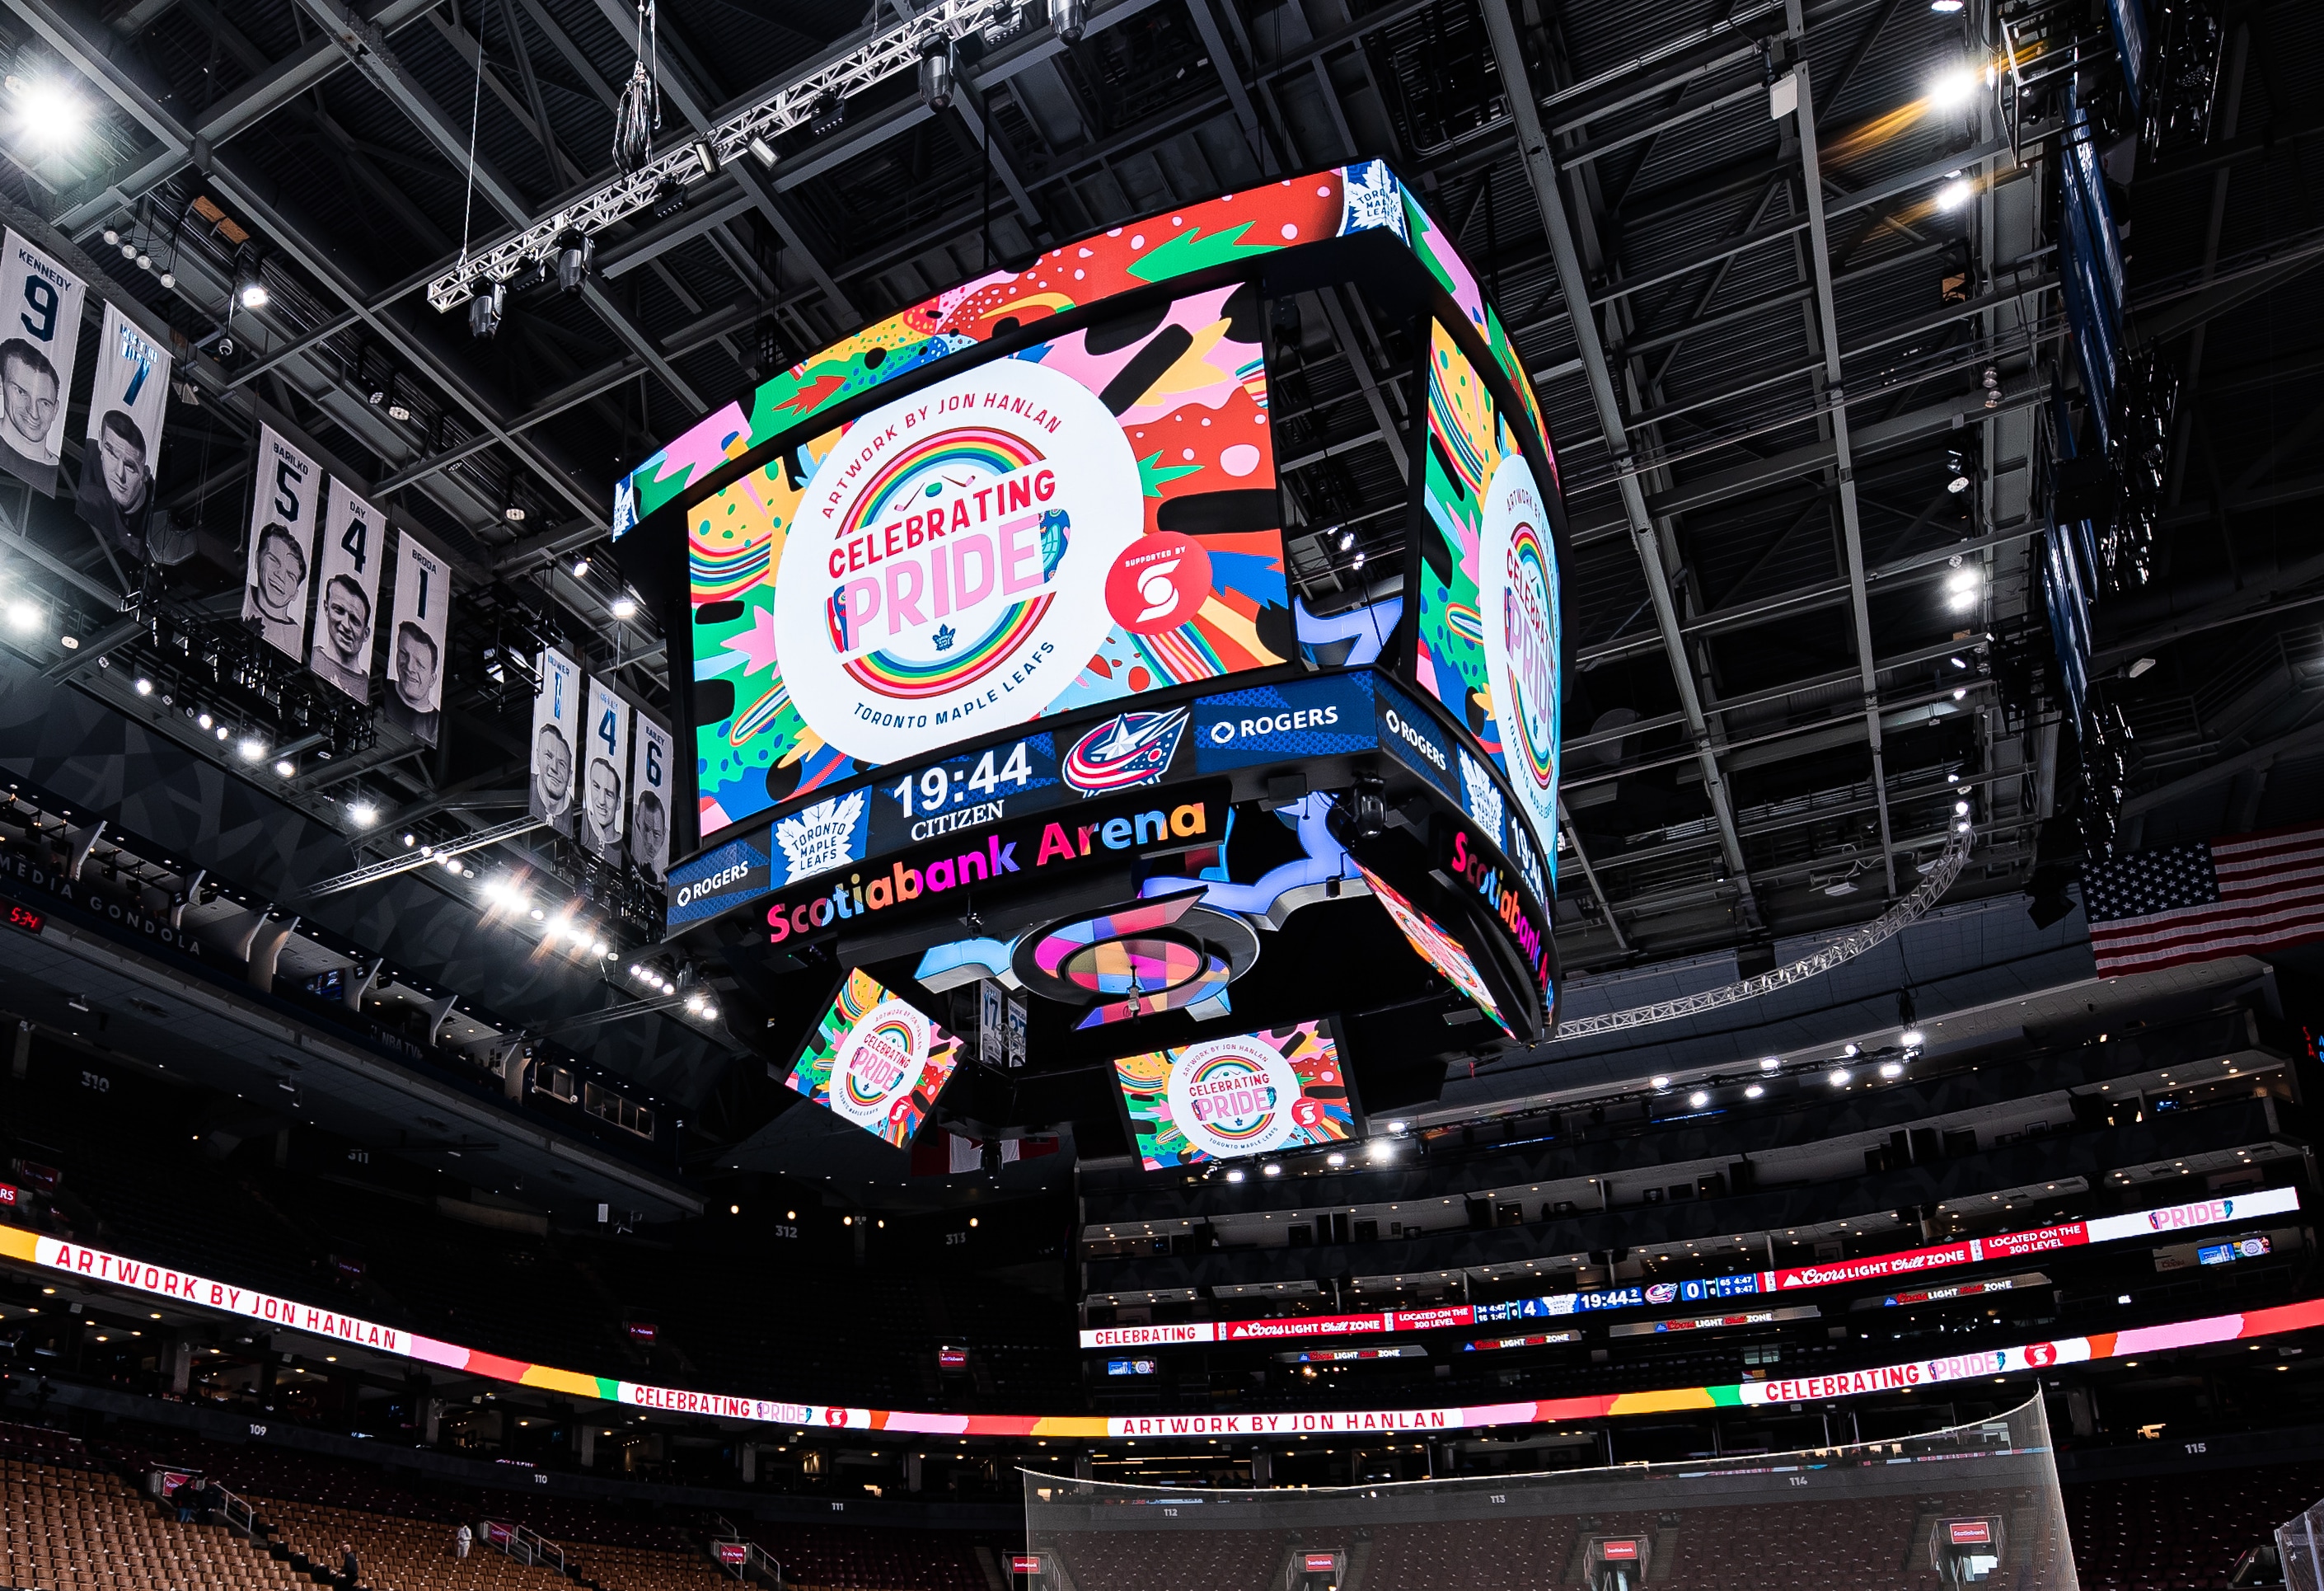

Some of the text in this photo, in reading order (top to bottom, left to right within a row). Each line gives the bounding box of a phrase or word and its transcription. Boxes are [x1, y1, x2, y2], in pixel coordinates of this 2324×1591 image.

[18, 248, 72, 292] KENNEDY
[21, 275, 59, 342] 9
[273, 441, 310, 476] BARILKO
[822, 392, 1062, 519] ARTWORK BY JON HANLAN
[274, 458, 302, 523] 5
[349, 500, 367, 519] DAY
[828, 469, 1056, 578] CELEBRATING
[340, 517, 368, 575] 4
[1125, 546, 1187, 567] SUPPORTED BY
[411, 548, 438, 576] BRODA
[417, 566, 429, 621] 1
[842, 513, 1046, 652] PRIDE
[554, 671, 563, 720] 1
[854, 641, 1055, 729] TORONTO MAPLE LEAFS
[598, 707, 616, 757] 4
[1239, 706, 1339, 738] ROGERS
[1401, 720, 1446, 770] ROGERS
[646, 739, 663, 788] 6
[893, 741, 1033, 819] 19:44
[911, 799, 1005, 842] CITIZEN
[791, 822, 846, 852] TORONTO
[799, 836, 837, 858] MAPLE
[766, 801, 1207, 944] Scotiabank Arena
[799, 849, 837, 871] LEAFS
[692, 860, 749, 900] ROGERS
[0, 851, 201, 956] MEDIA GONDOLA
[863, 1033, 911, 1069] CELEBRATING
[81, 1070, 110, 1092] 310
[850, 1047, 902, 1091] PRIDE
[1189, 1072, 1270, 1096] CELEBRATING
[1197, 1087, 1272, 1121] PRIDE
[2157, 1200, 2227, 1230] PRIDE
[775, 1224, 798, 1239] 312
[945, 1231, 967, 1246] 313
[1989, 1224, 2082, 1248] LOCATED ON THE
[2008, 1237, 2064, 1255] 300 LEVEL
[1800, 1251, 1966, 1285] Coors LIGHT Chill ZONE
[56, 1245, 396, 1349] ARTWORK BY JON HANLAN
[1581, 1291, 1629, 1309] 19:44
[1686, 1282, 1699, 1298] 0
[1928, 1288, 1958, 1300] LIGHT
[1984, 1279, 2013, 1293] ZONE
[1399, 1311, 1437, 1322] LOCATED
[1437, 1309, 1450, 1317] ON
[1450, 1307, 1469, 1317] THE
[1524, 1301, 1537, 1316] 4
[1695, 1318, 1723, 1328] LIGHT
[1746, 1312, 1773, 1322] ZONE
[1094, 1326, 1197, 1345] CELEBRATING
[1247, 1322, 1285, 1336] Coors
[1284, 1323, 1319, 1335] LIGHT
[1320, 1321, 1349, 1332] Chill
[1349, 1320, 1380, 1331] ZONE
[1413, 1319, 1455, 1329] 300 LEVEL
[1333, 1351, 1359, 1359] LIGHT
[1378, 1349, 1401, 1358] ZONE
[1500, 1338, 1525, 1348] LIGHT
[1545, 1333, 1570, 1343] ZONE
[1765, 1352, 1998, 1402] CELEBRATING PRIDE
[635, 1386, 808, 1424] CELEBRATING PRIDE
[250, 1424, 267, 1436] 109
[1123, 1411, 1445, 1434] ARTWORK BY JON HANLAN
[2185, 1443, 2206, 1454] 115
[534, 1474, 547, 1484] 110
[1789, 1476, 1808, 1486] 114
[832, 1503, 844, 1511] 111
[1164, 1508, 1178, 1517] 112
[1490, 1495, 1506, 1504] 113
